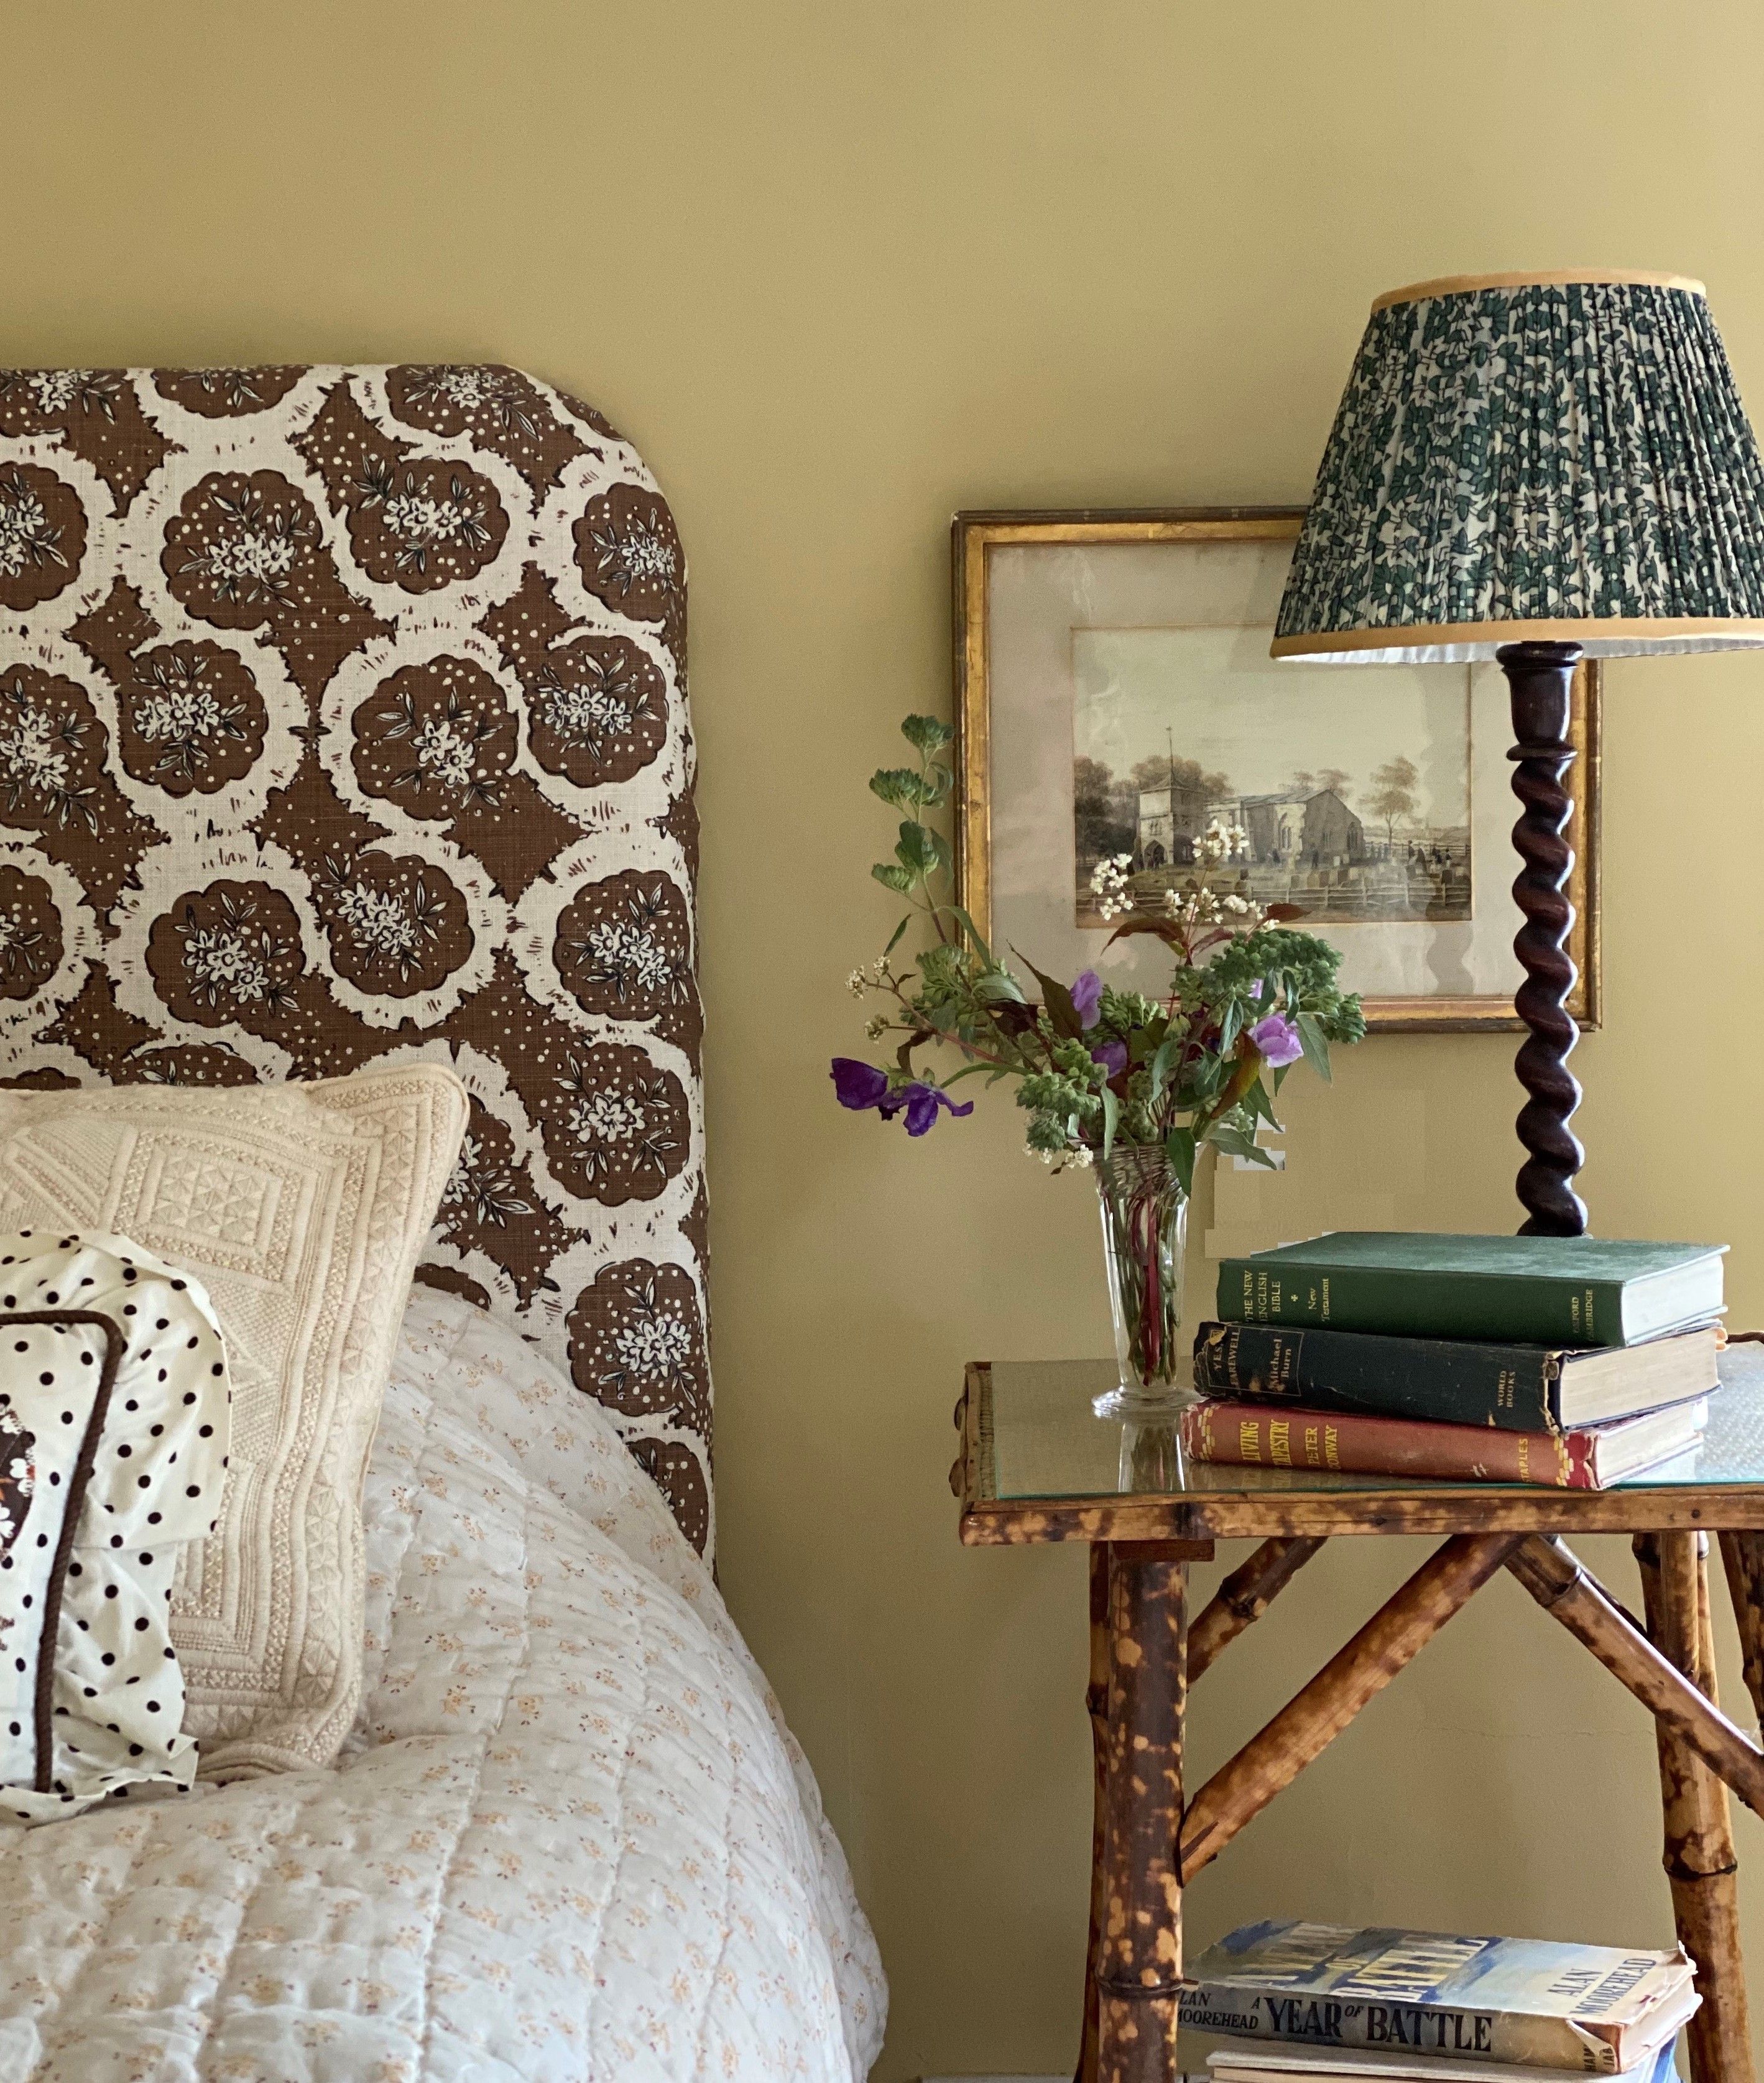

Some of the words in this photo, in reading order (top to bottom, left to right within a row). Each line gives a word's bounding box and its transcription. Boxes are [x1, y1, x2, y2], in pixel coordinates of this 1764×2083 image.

[1244, 1270, 1253, 1296] NEW
[1258, 1272, 1268, 1322] ENGLISH
[1272, 1281, 1281, 1312] BIBLE
[1308, 1288, 1318, 1310] New
[1321, 1278, 1331, 1322] Testament
[1244, 1299, 1254, 1323] THE
[1585, 1289, 1594, 1341] MBRIDGE
[1227, 1331, 1240, 1387] FAREWELL
[1268, 1339, 1283, 1390] Michael
[1281, 1349, 1291, 1379] Burn
[1497, 1370, 1507, 1406] WORLD
[1506, 1371, 1515, 1408] BOOKS
[1240, 1421, 1262, 1461] LIVING
[1270, 1419, 1293, 1466] TAPESTRY
[1305, 1426, 1320, 1465] PETER
[1325, 1425, 1341, 1469] CONWAY
[1180, 1990, 1212, 2007] LAN
[1547, 1968, 1604, 1998] ALAN
[1569, 1959, 1657, 2016] MOOREHEAD
[1250, 1996, 1261, 2010] A
[1263, 1997, 1343, 2038] YEAR
[1344, 2005, 1364, 2018] OF
[1366, 2006, 1492, 2052] BATTLE
